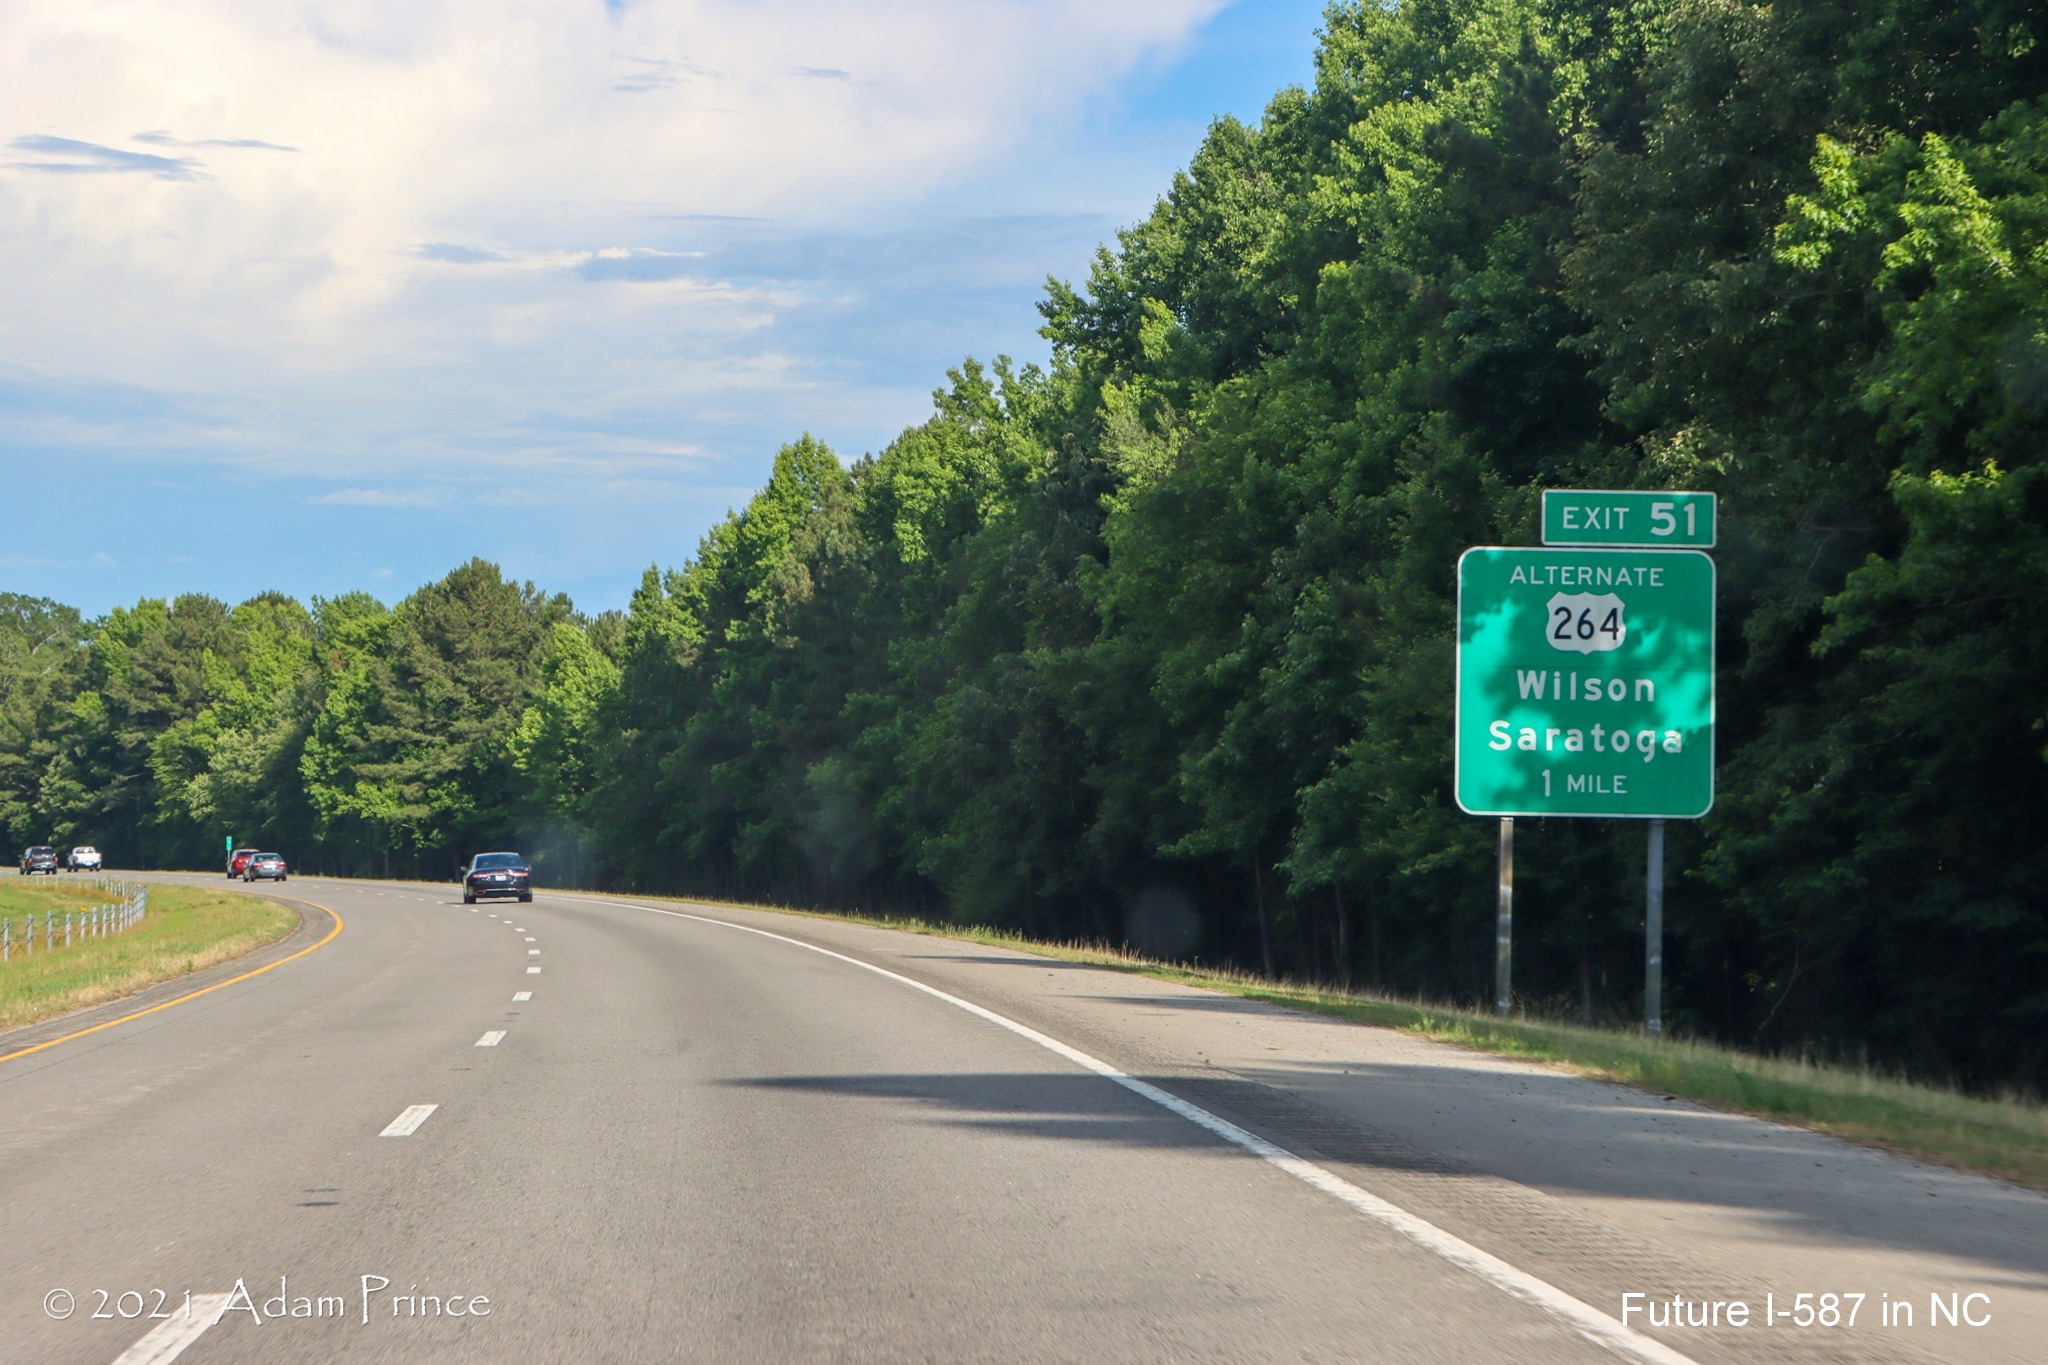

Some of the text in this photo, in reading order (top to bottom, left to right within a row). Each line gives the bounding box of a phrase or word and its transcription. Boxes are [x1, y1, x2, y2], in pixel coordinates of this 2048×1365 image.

[1562, 502, 1696, 536] EXIT 51
[1509, 565, 1665, 587] ALTERNATE
[1553, 606, 1620, 641] 264
[1516, 669, 1655, 702] Wilson
[1488, 719, 1683, 764] Saratoga
[1541, 769, 1628, 797] 1 MILE
